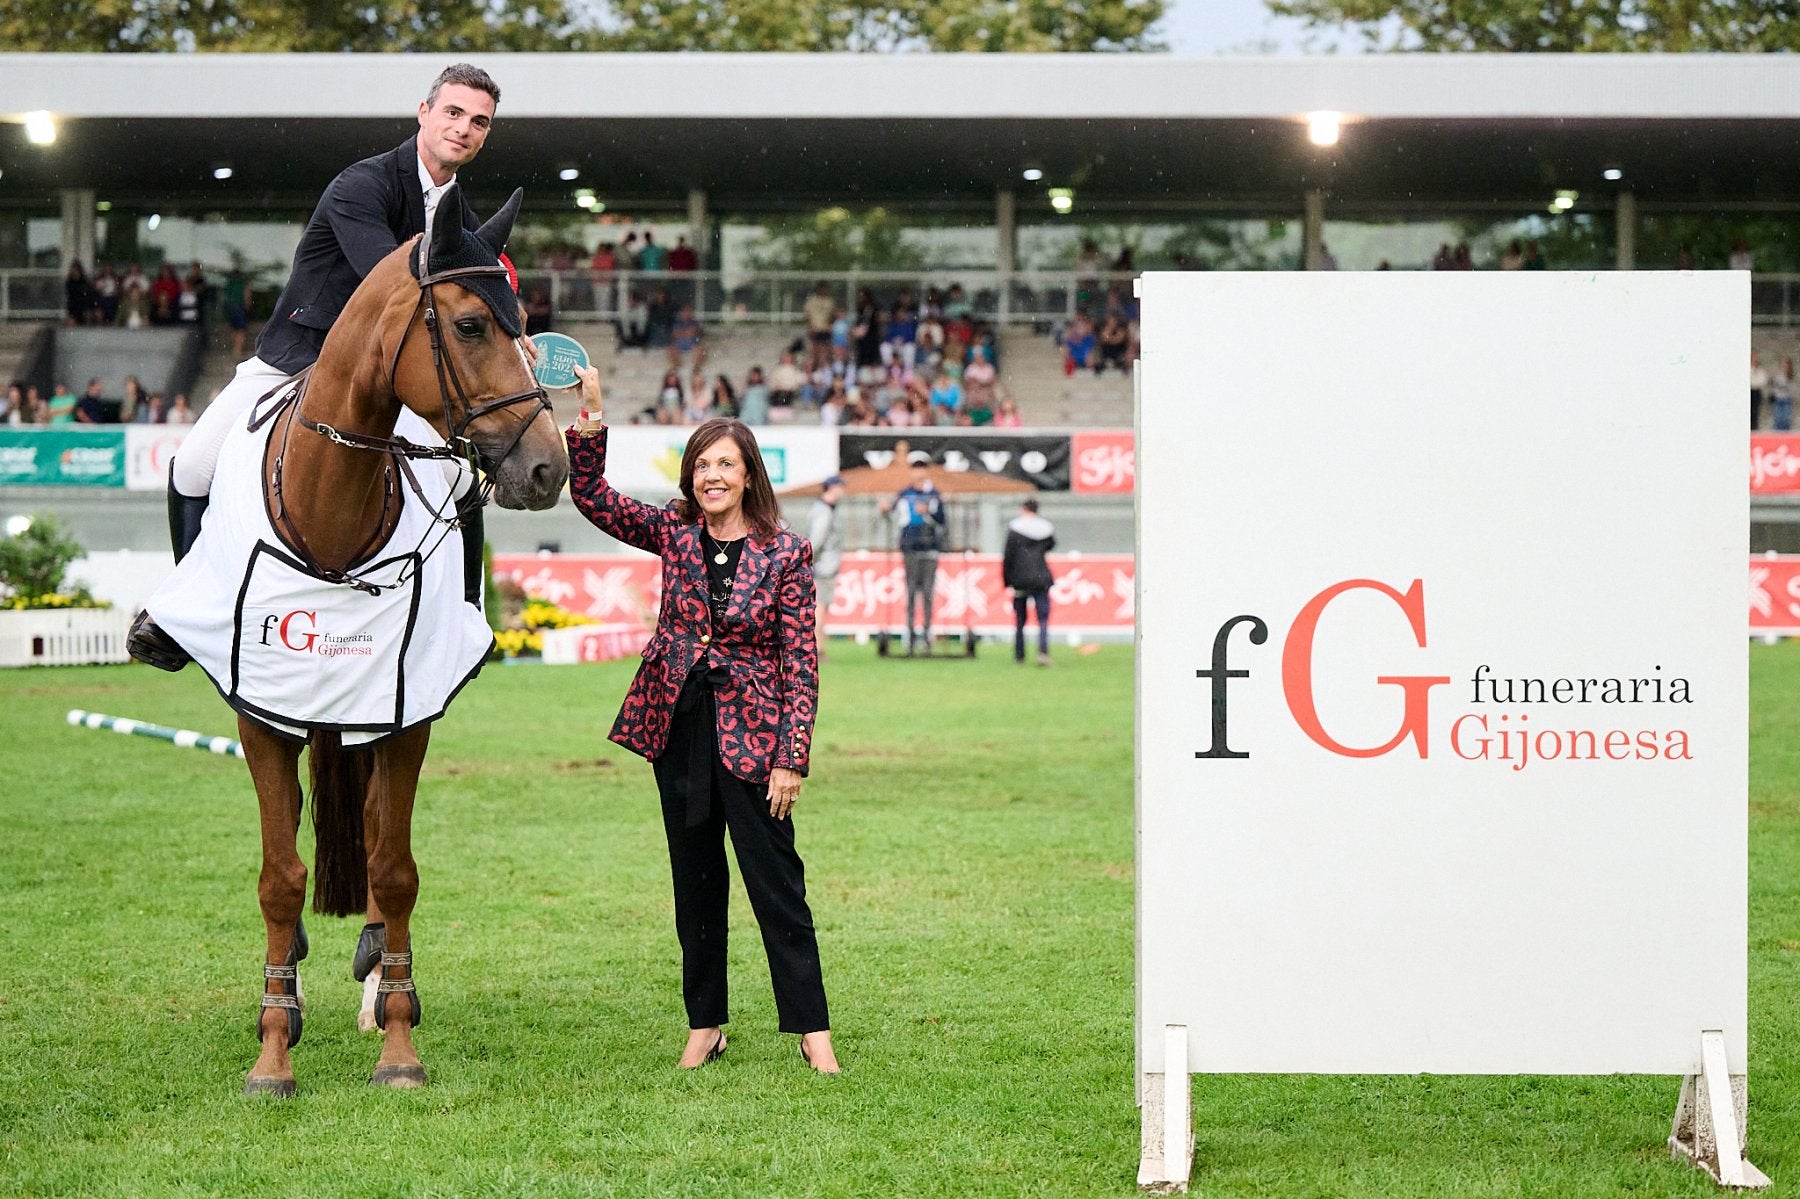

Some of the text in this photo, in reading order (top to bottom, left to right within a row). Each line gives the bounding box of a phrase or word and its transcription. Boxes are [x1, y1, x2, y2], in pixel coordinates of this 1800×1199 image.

[318, 644, 372, 657] Gijonesa
[324, 632, 373, 643] funeraria
[1471, 665, 1694, 704] funeraria
[1450, 714, 1694, 771] Gijonesa
